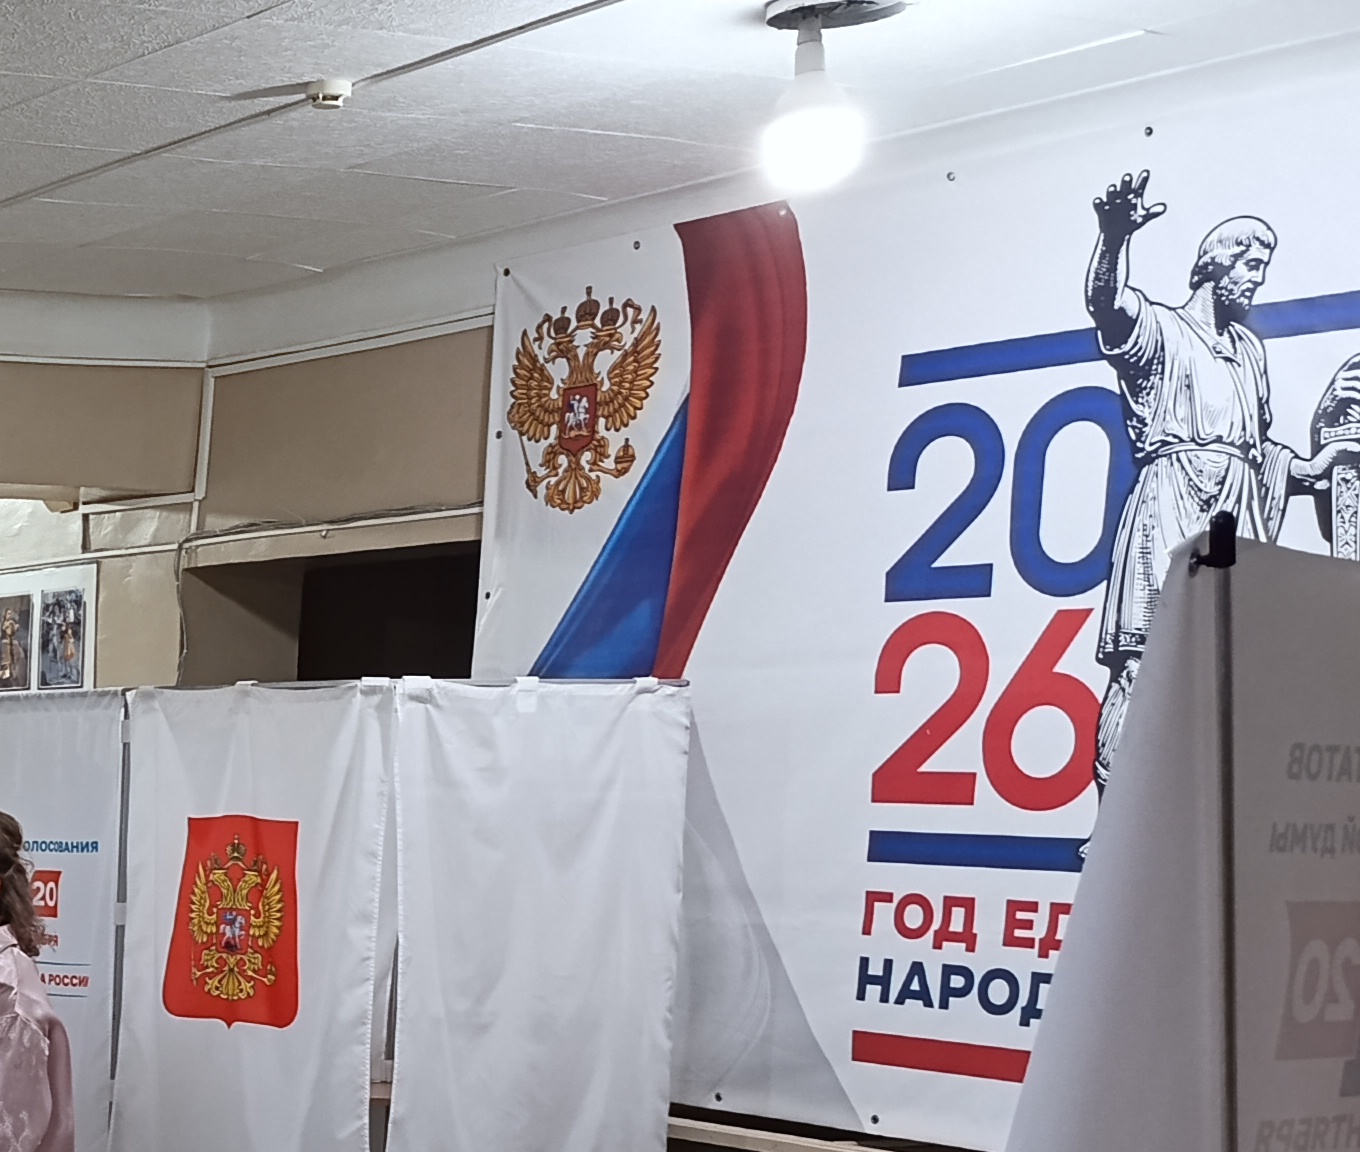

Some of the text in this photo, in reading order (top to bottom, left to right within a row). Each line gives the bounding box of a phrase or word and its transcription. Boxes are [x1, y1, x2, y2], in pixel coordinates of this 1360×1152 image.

[884, 385, 1143, 602] 20
[871, 609, 1100, 812] 26
[23, 840, 99, 853] ОЛОСОВАНИЯ
[32, 881, 57, 907] 20
[861, 890, 978, 953] ГОД
